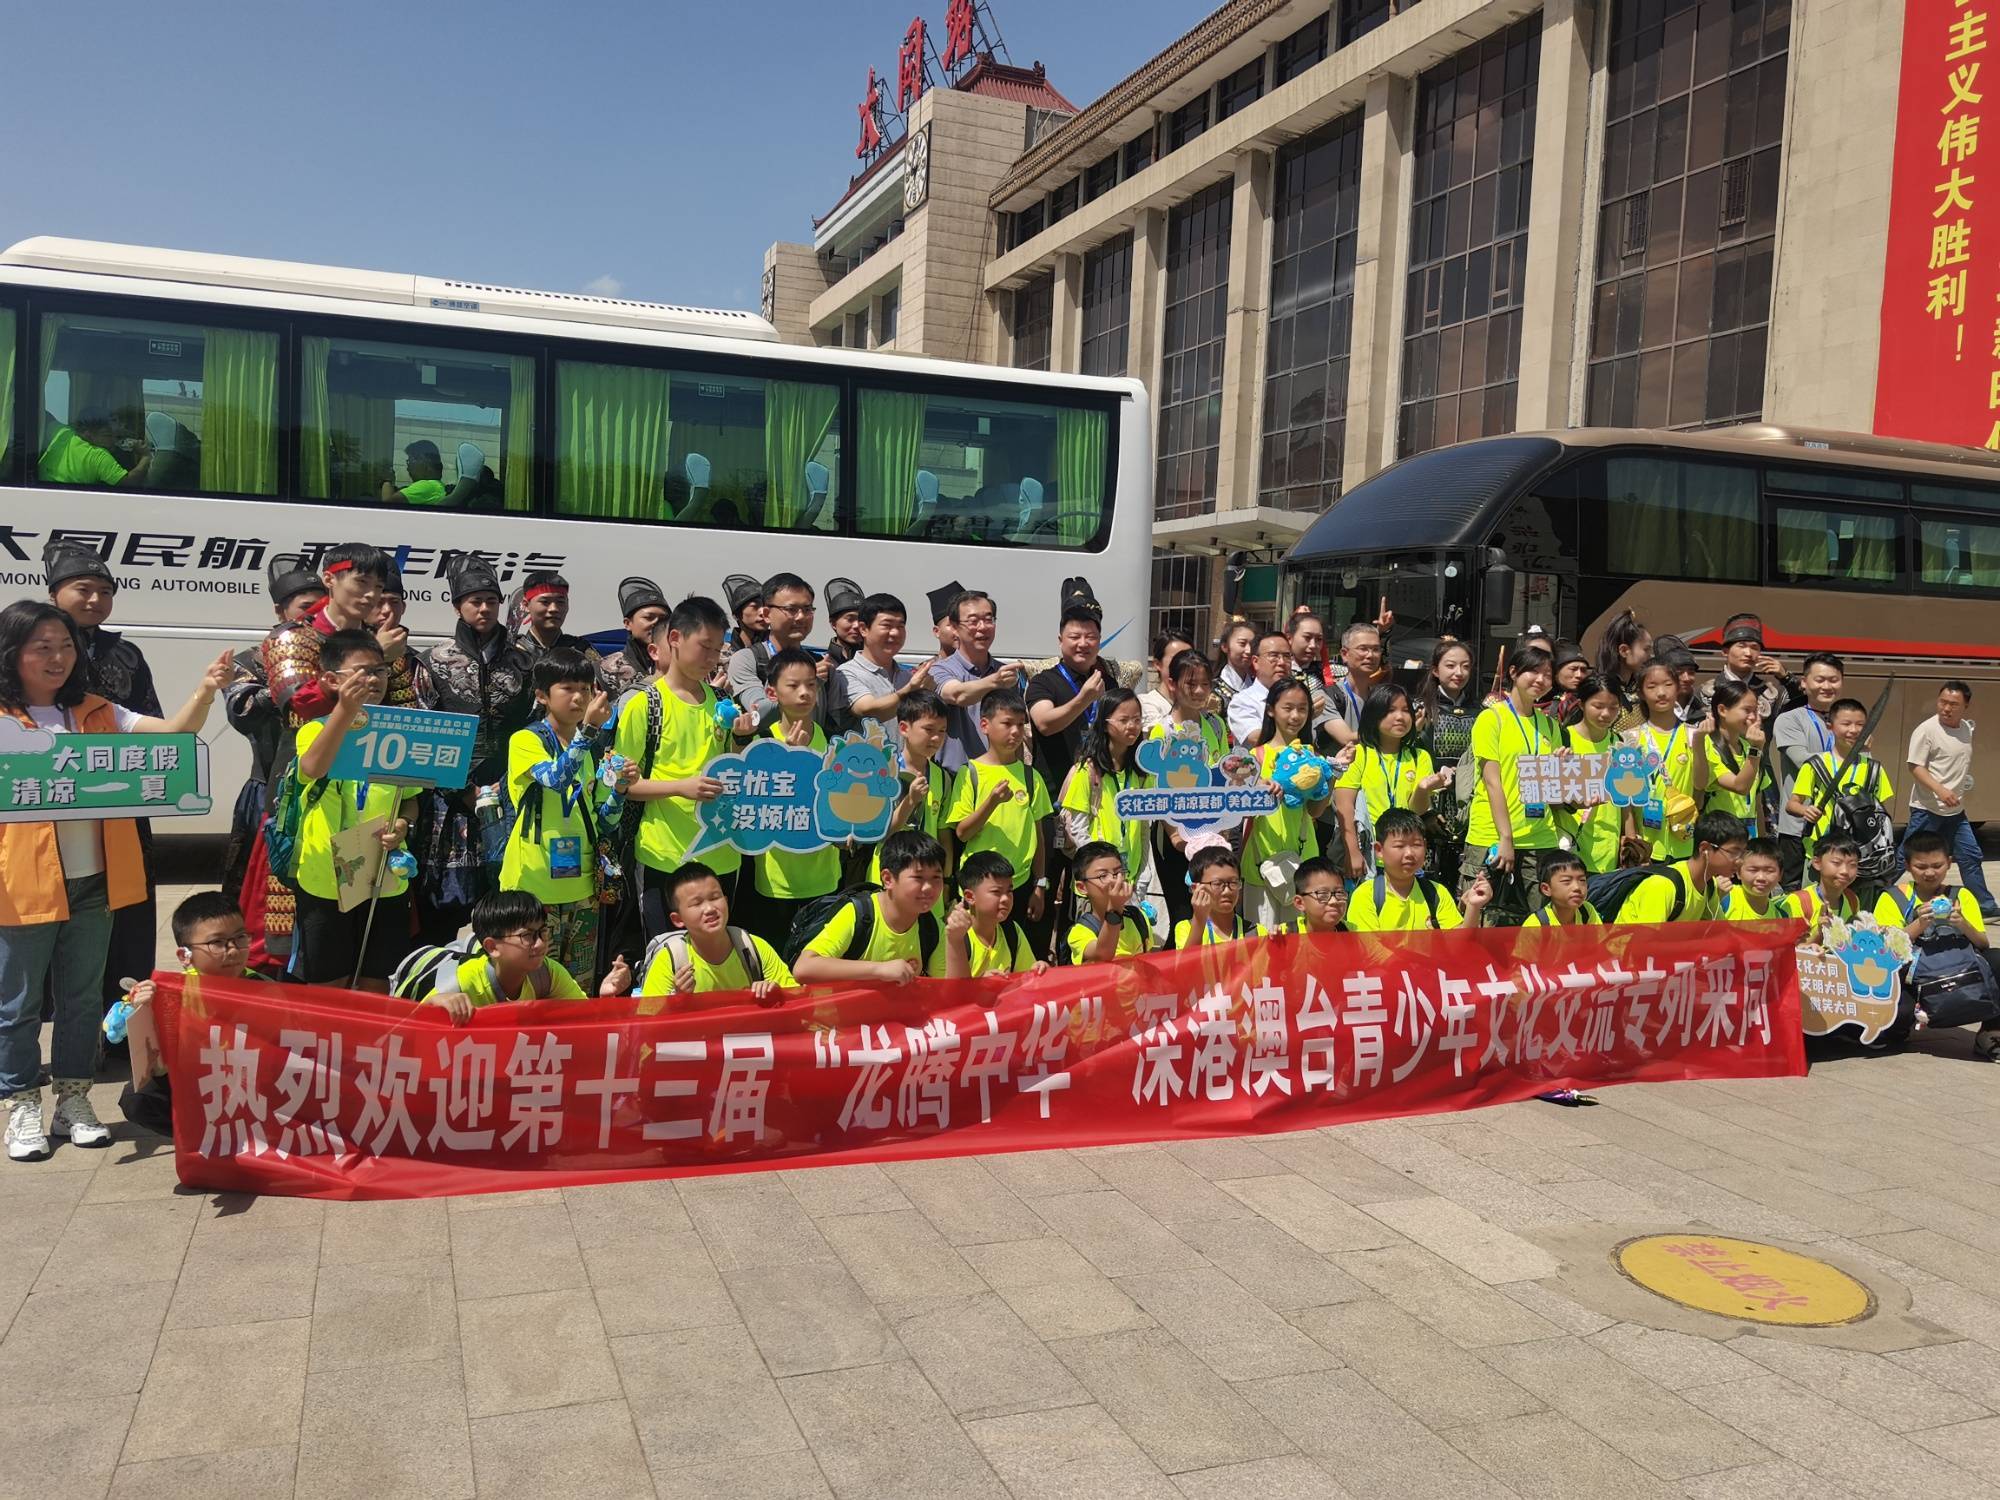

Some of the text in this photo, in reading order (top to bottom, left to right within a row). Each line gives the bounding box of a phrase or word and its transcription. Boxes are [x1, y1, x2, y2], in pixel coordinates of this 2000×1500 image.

[1926, 0, 1987, 361] 主义伟大胜利！
[151, 578, 260, 594] AUTOMOBILE
[52, 744, 180, 773] 大同度假
[355, 731, 461, 770] 10号团
[1518, 754, 1603, 778] 云动天下
[11, 774, 168, 806] 清凉一夏
[717, 767, 797, 798] 忘忧宝
[1519, 778, 1606, 804] 潮起大同
[1120, 794, 1275, 812] 文化古都 清凉夏都 美食之都
[730, 804, 811, 833] 没烦恼
[1800, 976, 1848, 998] 文明大同
